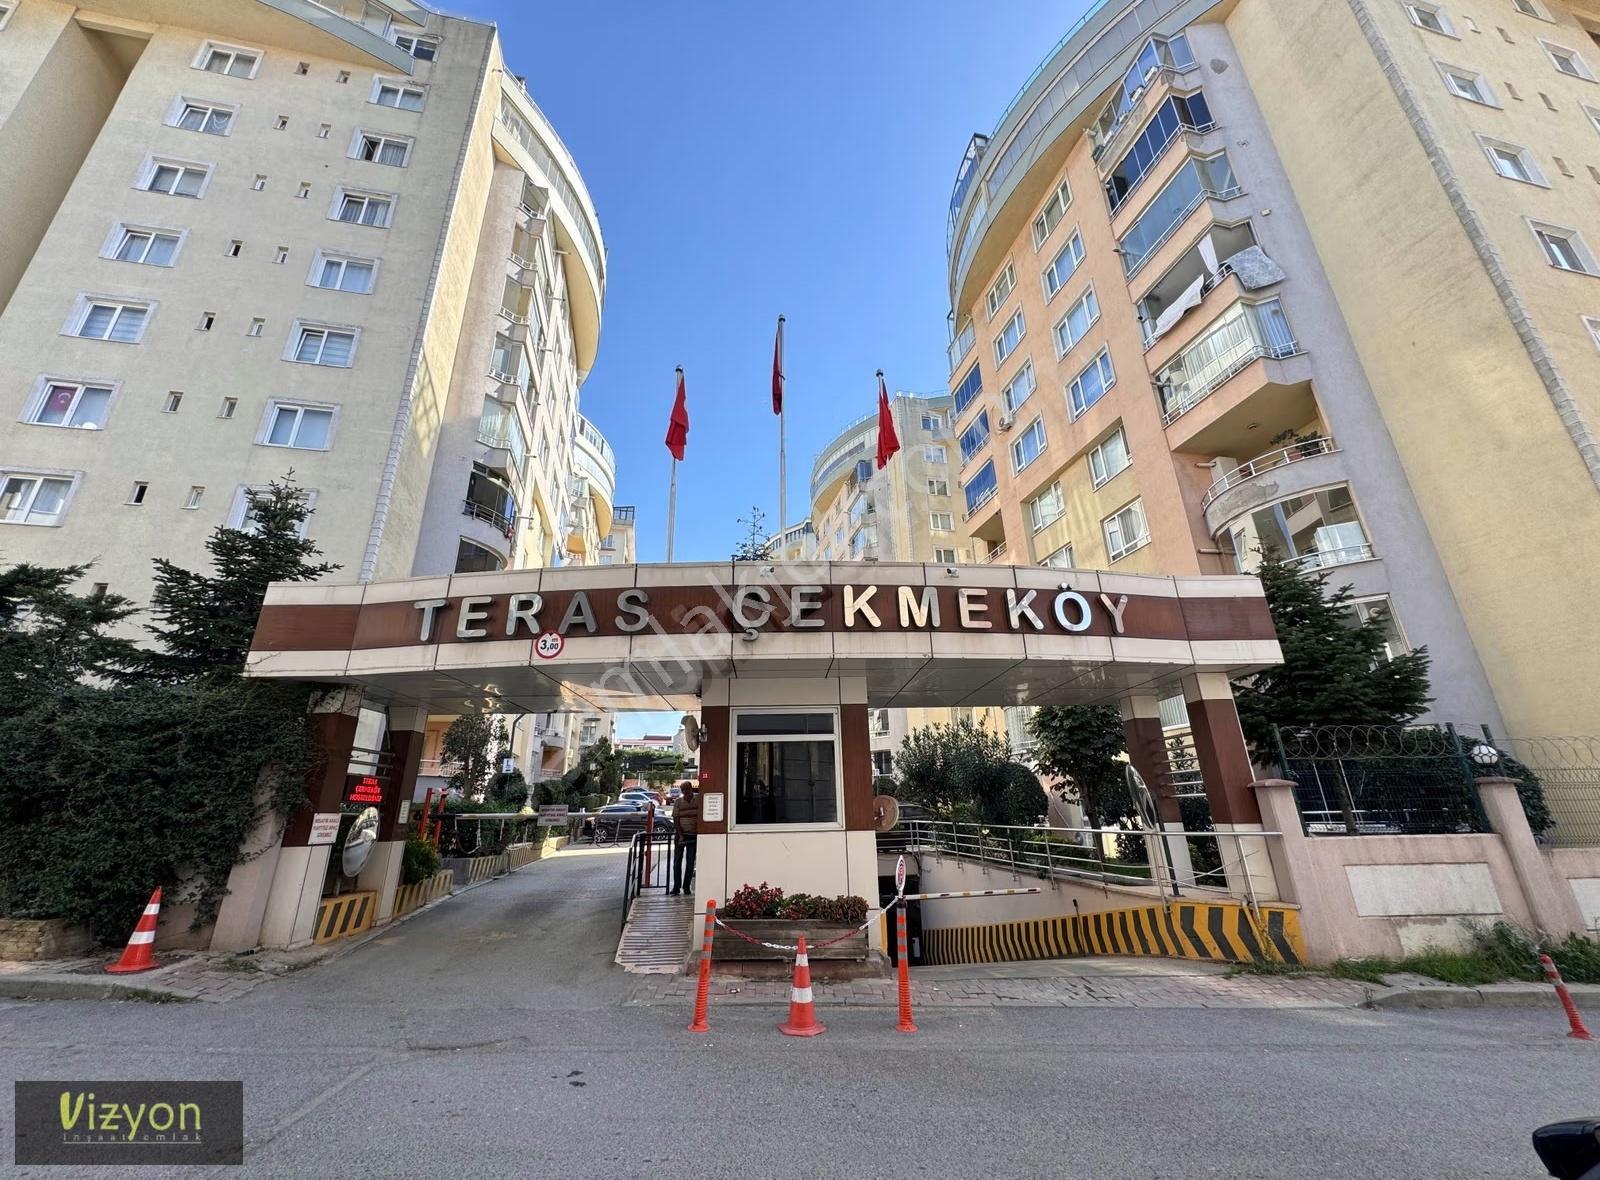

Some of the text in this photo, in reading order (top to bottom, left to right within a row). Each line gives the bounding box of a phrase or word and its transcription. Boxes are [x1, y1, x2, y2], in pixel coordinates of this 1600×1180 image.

[413, 581, 1129, 642] TERAS ÇEKMEKÖY
[540, 639, 559, 652] 3,00
